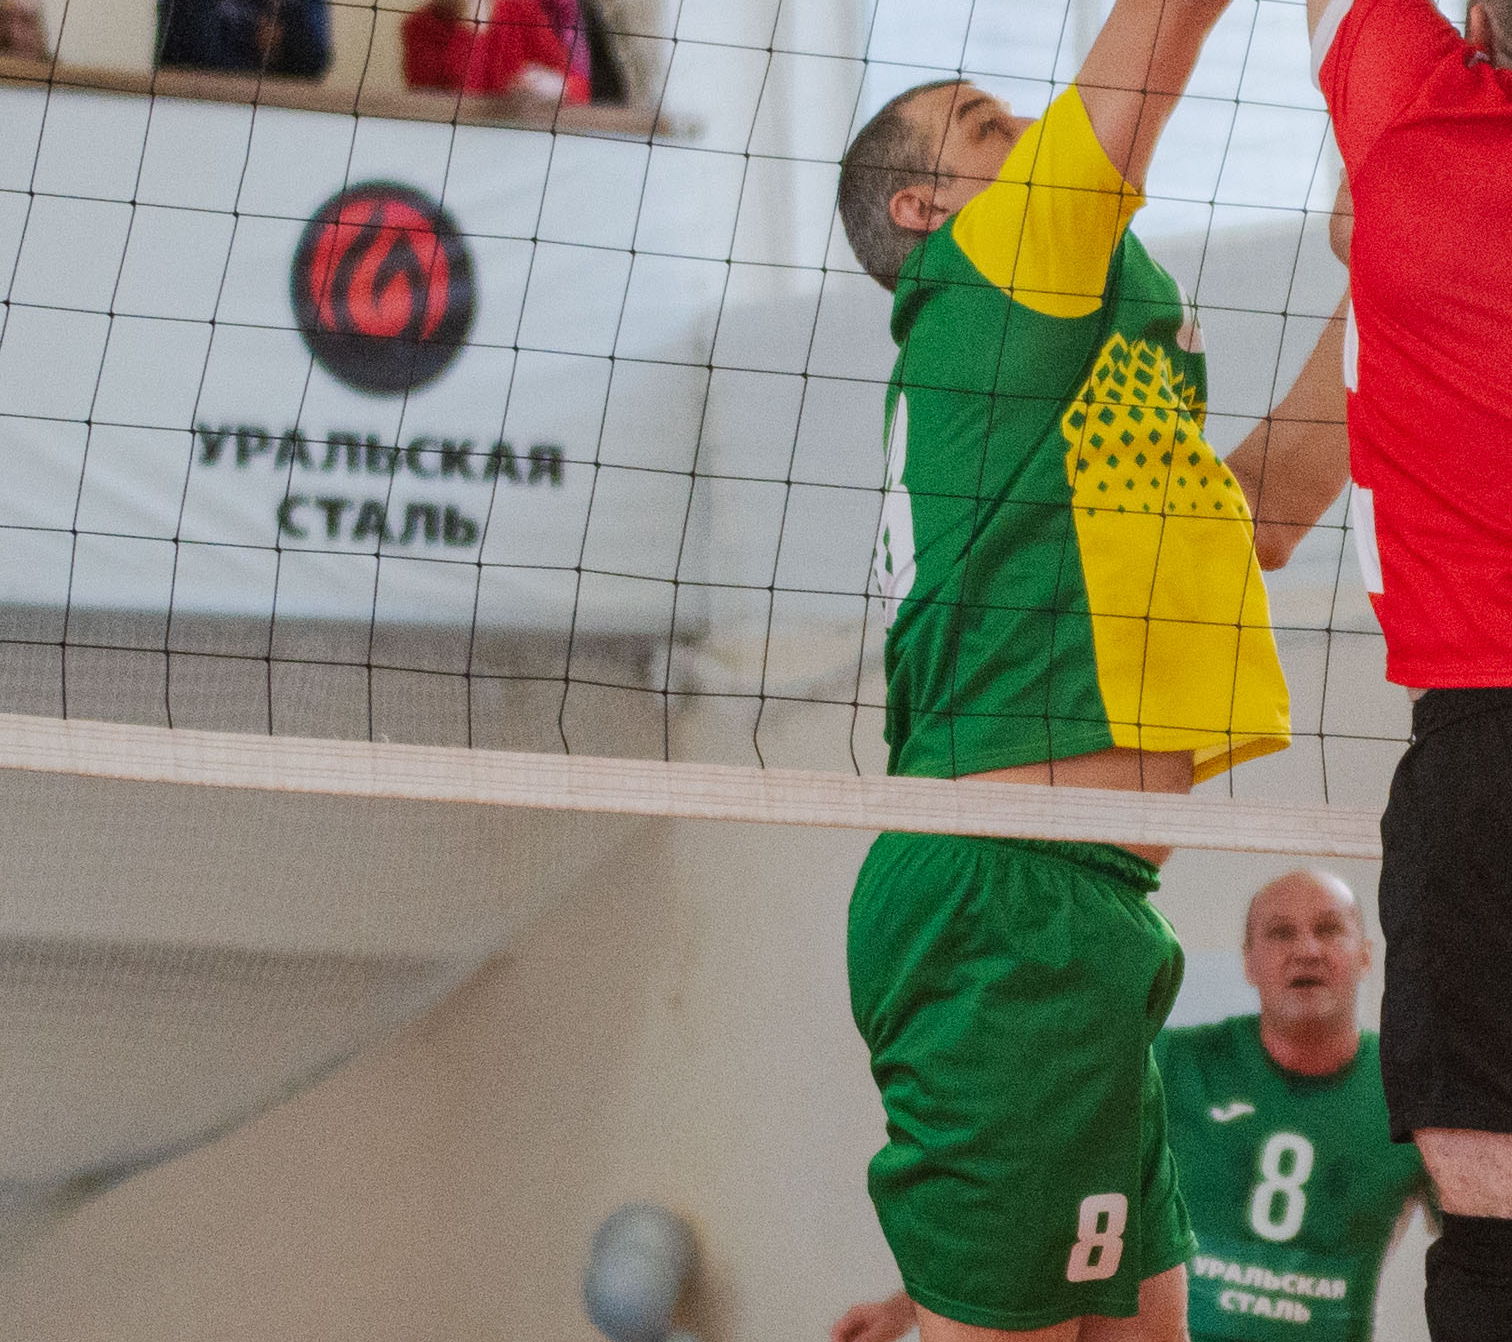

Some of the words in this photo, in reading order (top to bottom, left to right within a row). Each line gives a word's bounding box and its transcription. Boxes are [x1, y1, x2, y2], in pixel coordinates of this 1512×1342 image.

[196, 422, 565, 488] УРАЛЬСКАЯ
[277, 493, 480, 549] СТАЛЬ
[1251, 1132, 1315, 1242] 8
[1067, 1192, 1128, 1283] 8
[1194, 1256, 1348, 1299] УРАЛЬСКАЯ
[1219, 1289, 1312, 1324] СТАЛЬ
